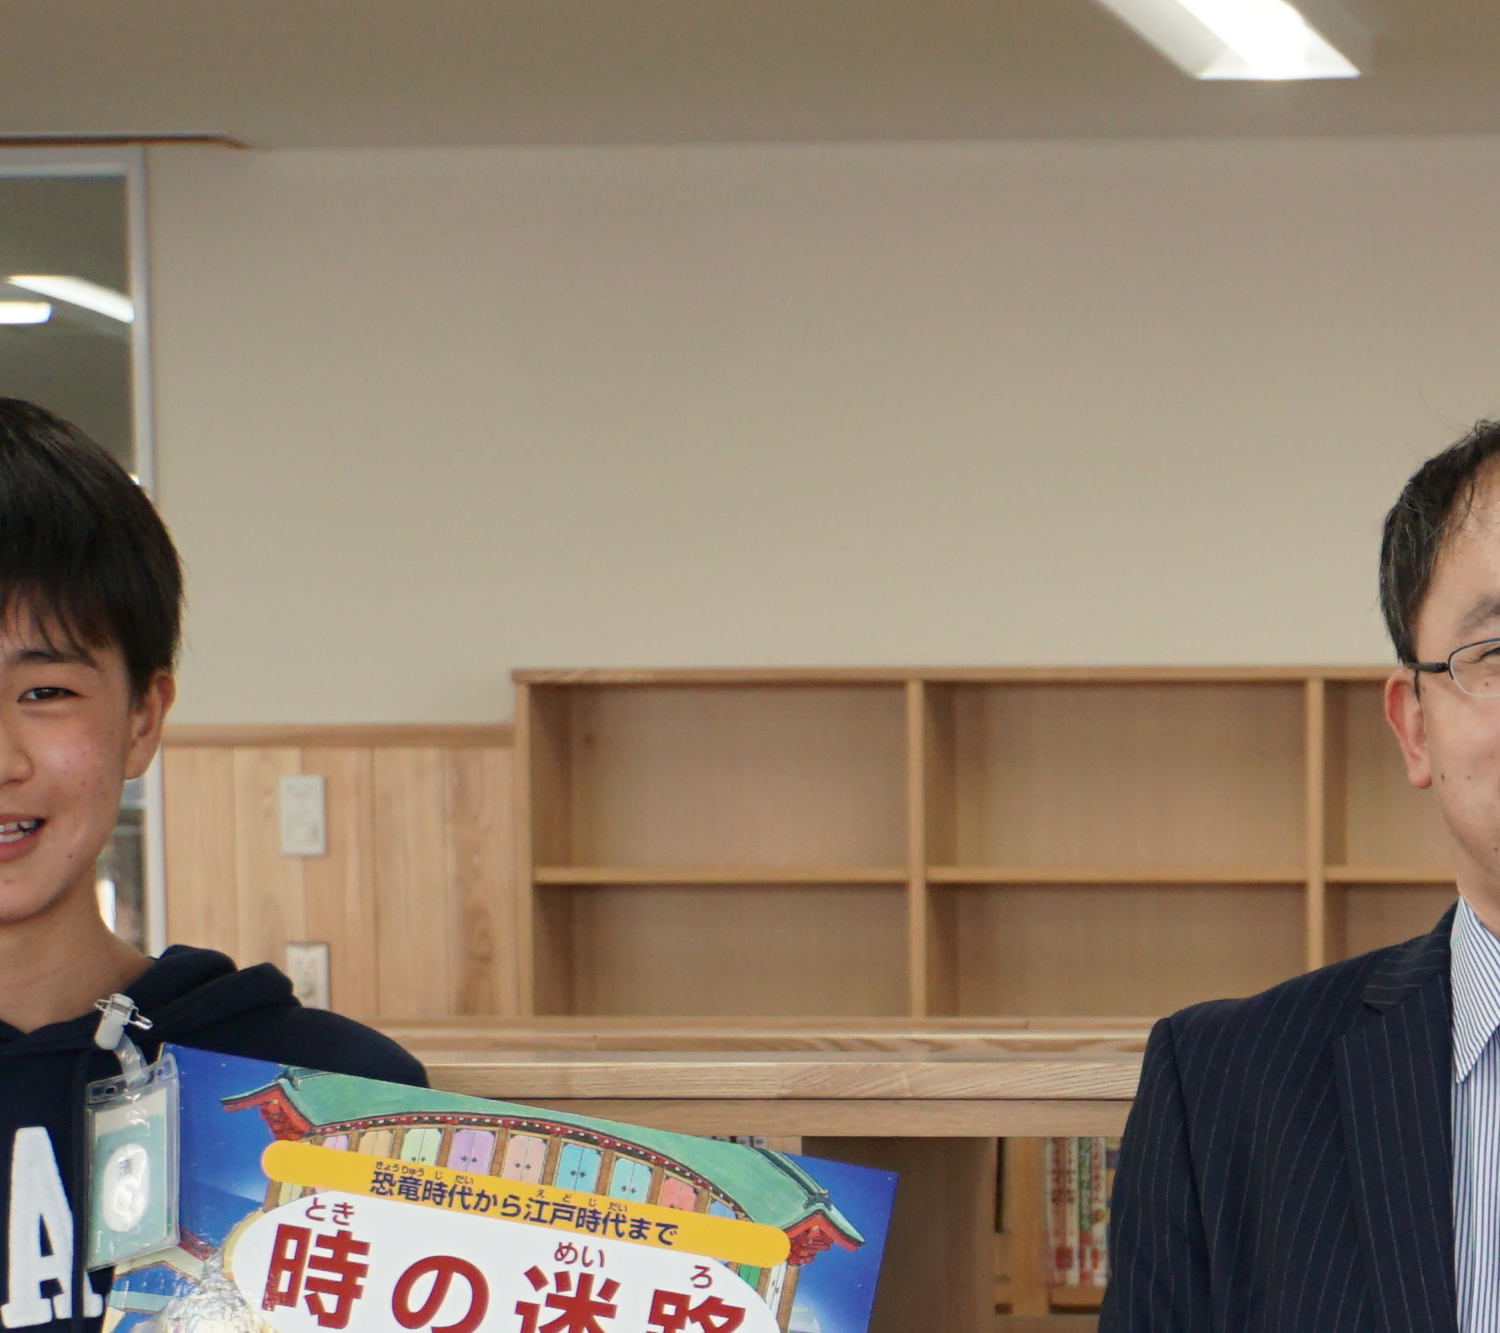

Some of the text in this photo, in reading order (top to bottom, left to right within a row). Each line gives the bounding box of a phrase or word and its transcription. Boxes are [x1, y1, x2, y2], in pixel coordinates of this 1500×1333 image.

[370, 1172, 679, 1246] 恐竜時代から江戸時代まで
